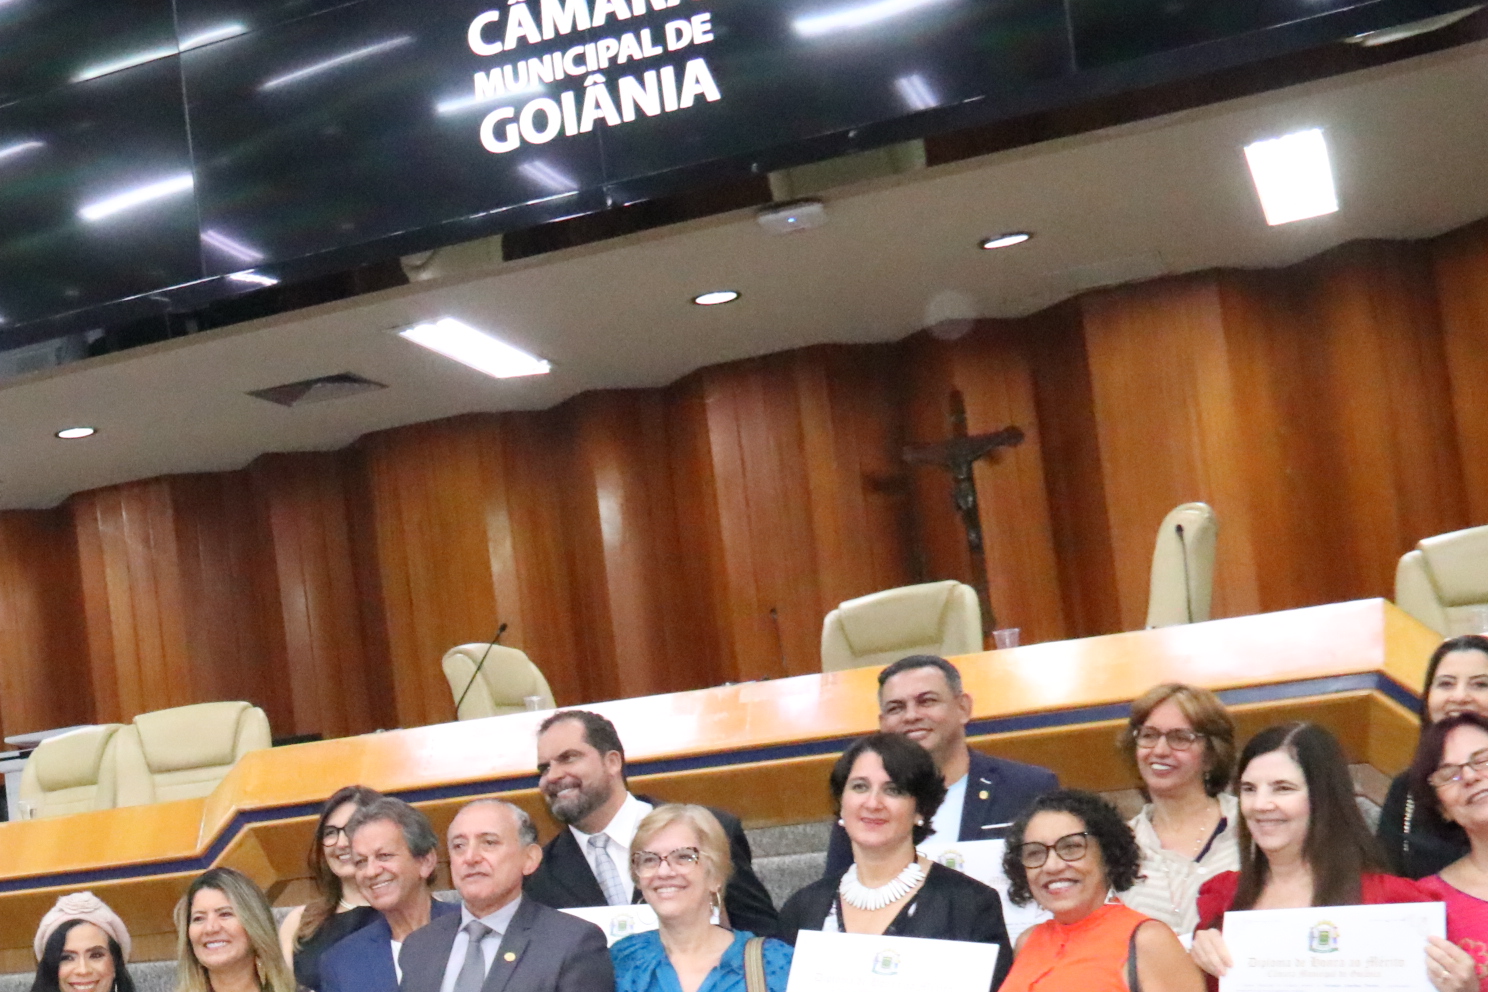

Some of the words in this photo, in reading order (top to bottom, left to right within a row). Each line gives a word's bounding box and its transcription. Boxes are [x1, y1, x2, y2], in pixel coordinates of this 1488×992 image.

[474, 28, 663, 100] MUNICIPAL
[665, 12, 714, 51] DE
[479, 58, 722, 154] GOIÂNIA
[1248, 957, 1291, 968] Diploma
